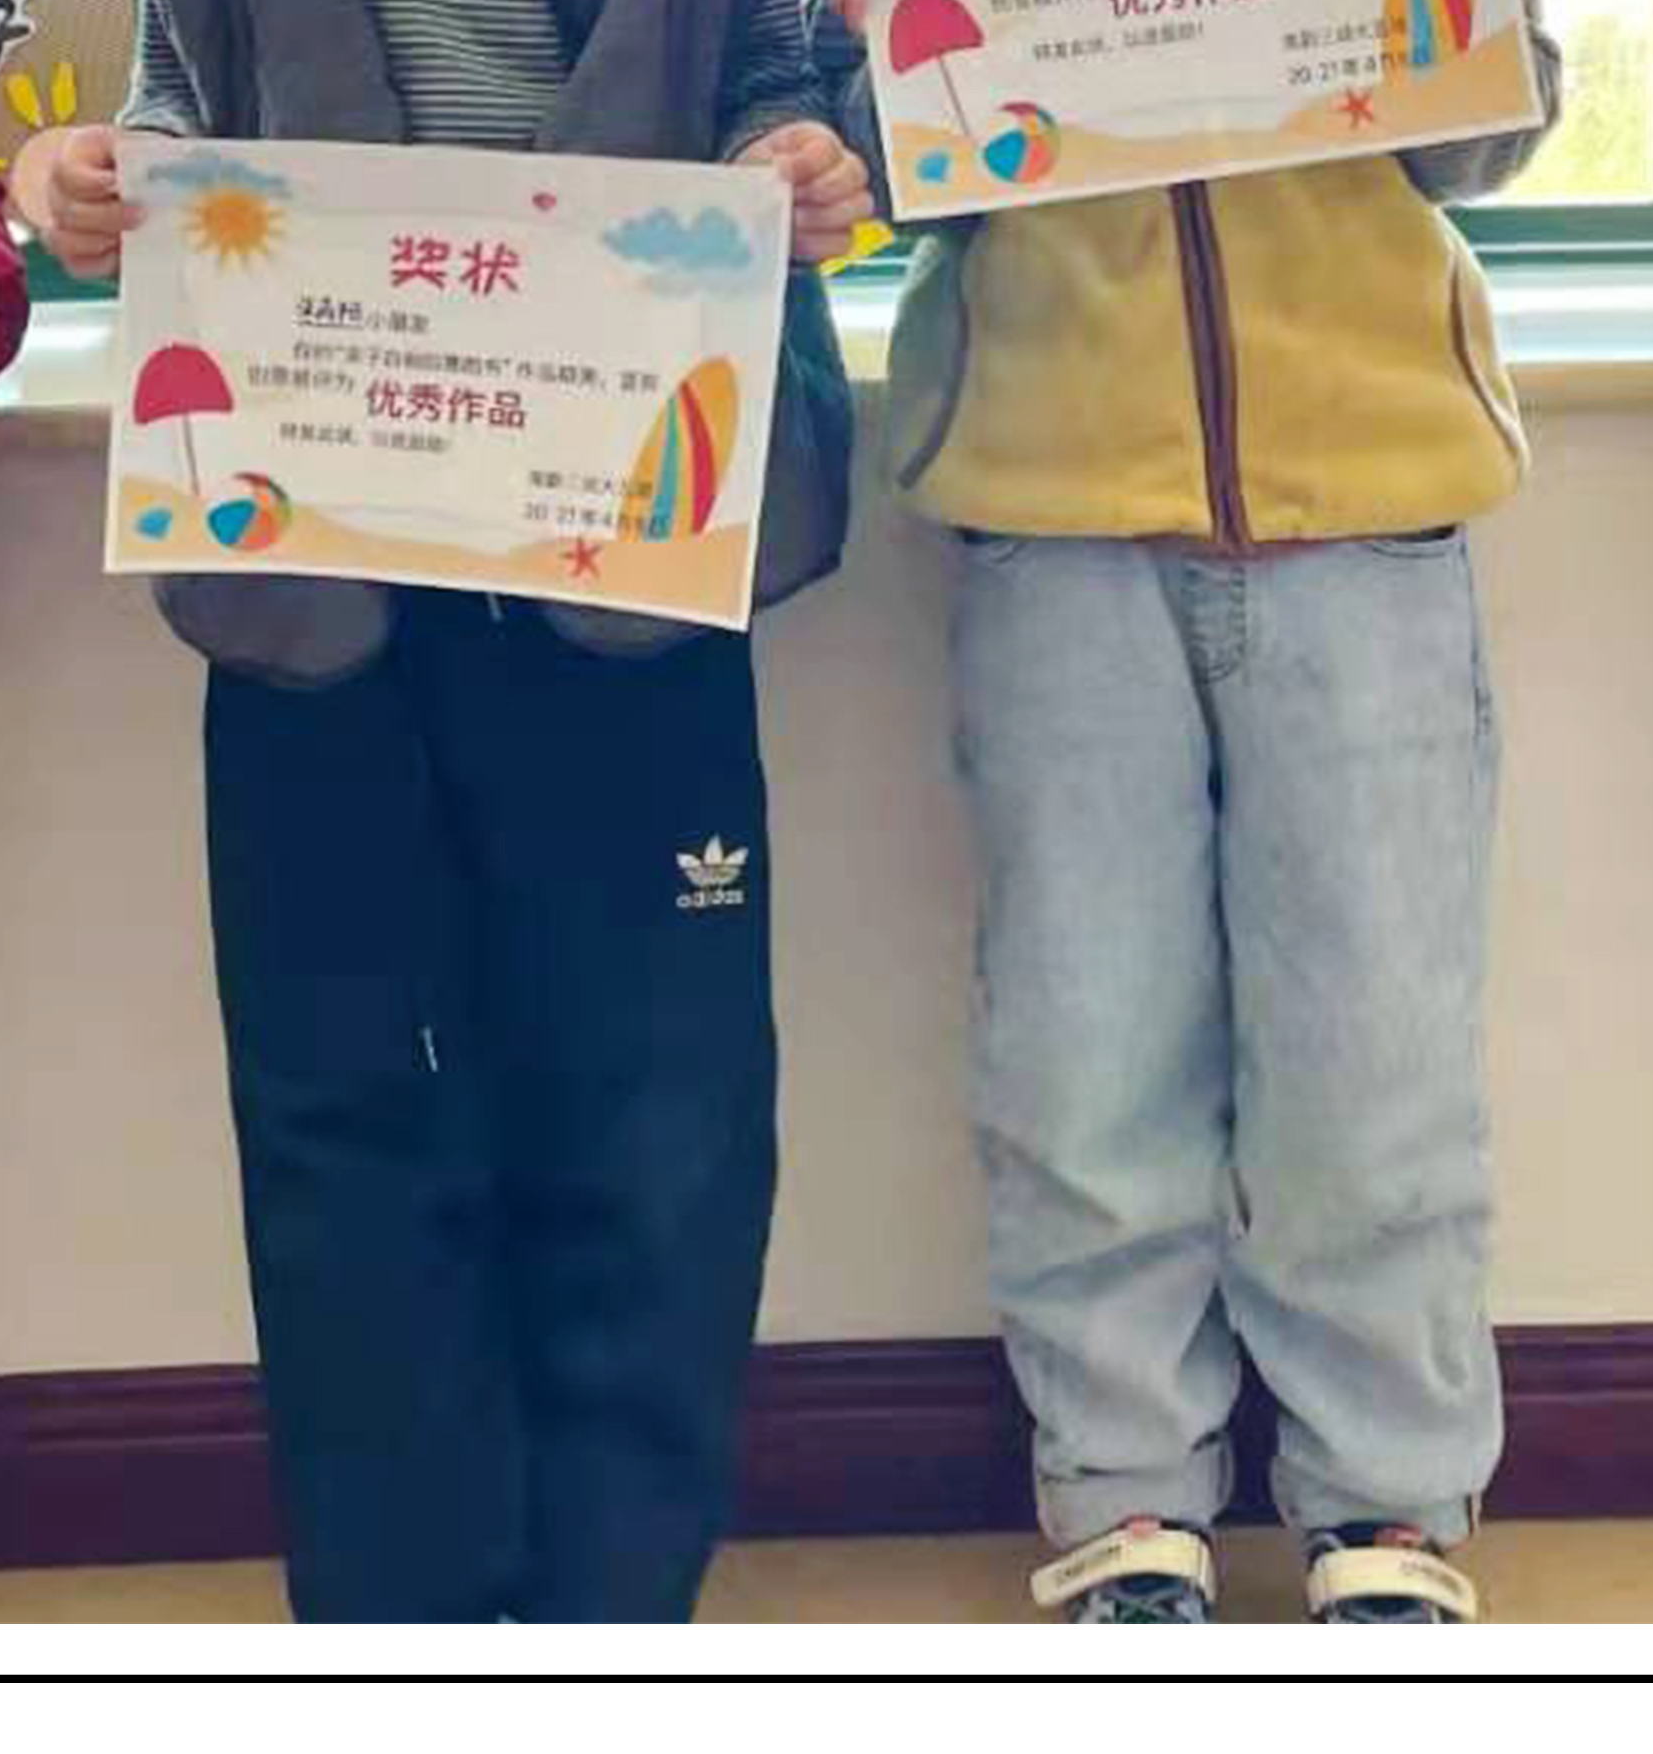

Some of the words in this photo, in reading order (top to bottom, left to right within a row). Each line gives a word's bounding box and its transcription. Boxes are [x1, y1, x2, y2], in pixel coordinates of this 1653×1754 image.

[389, 234, 523, 297] 奖状
[365, 377, 528, 431] 优秀作品
